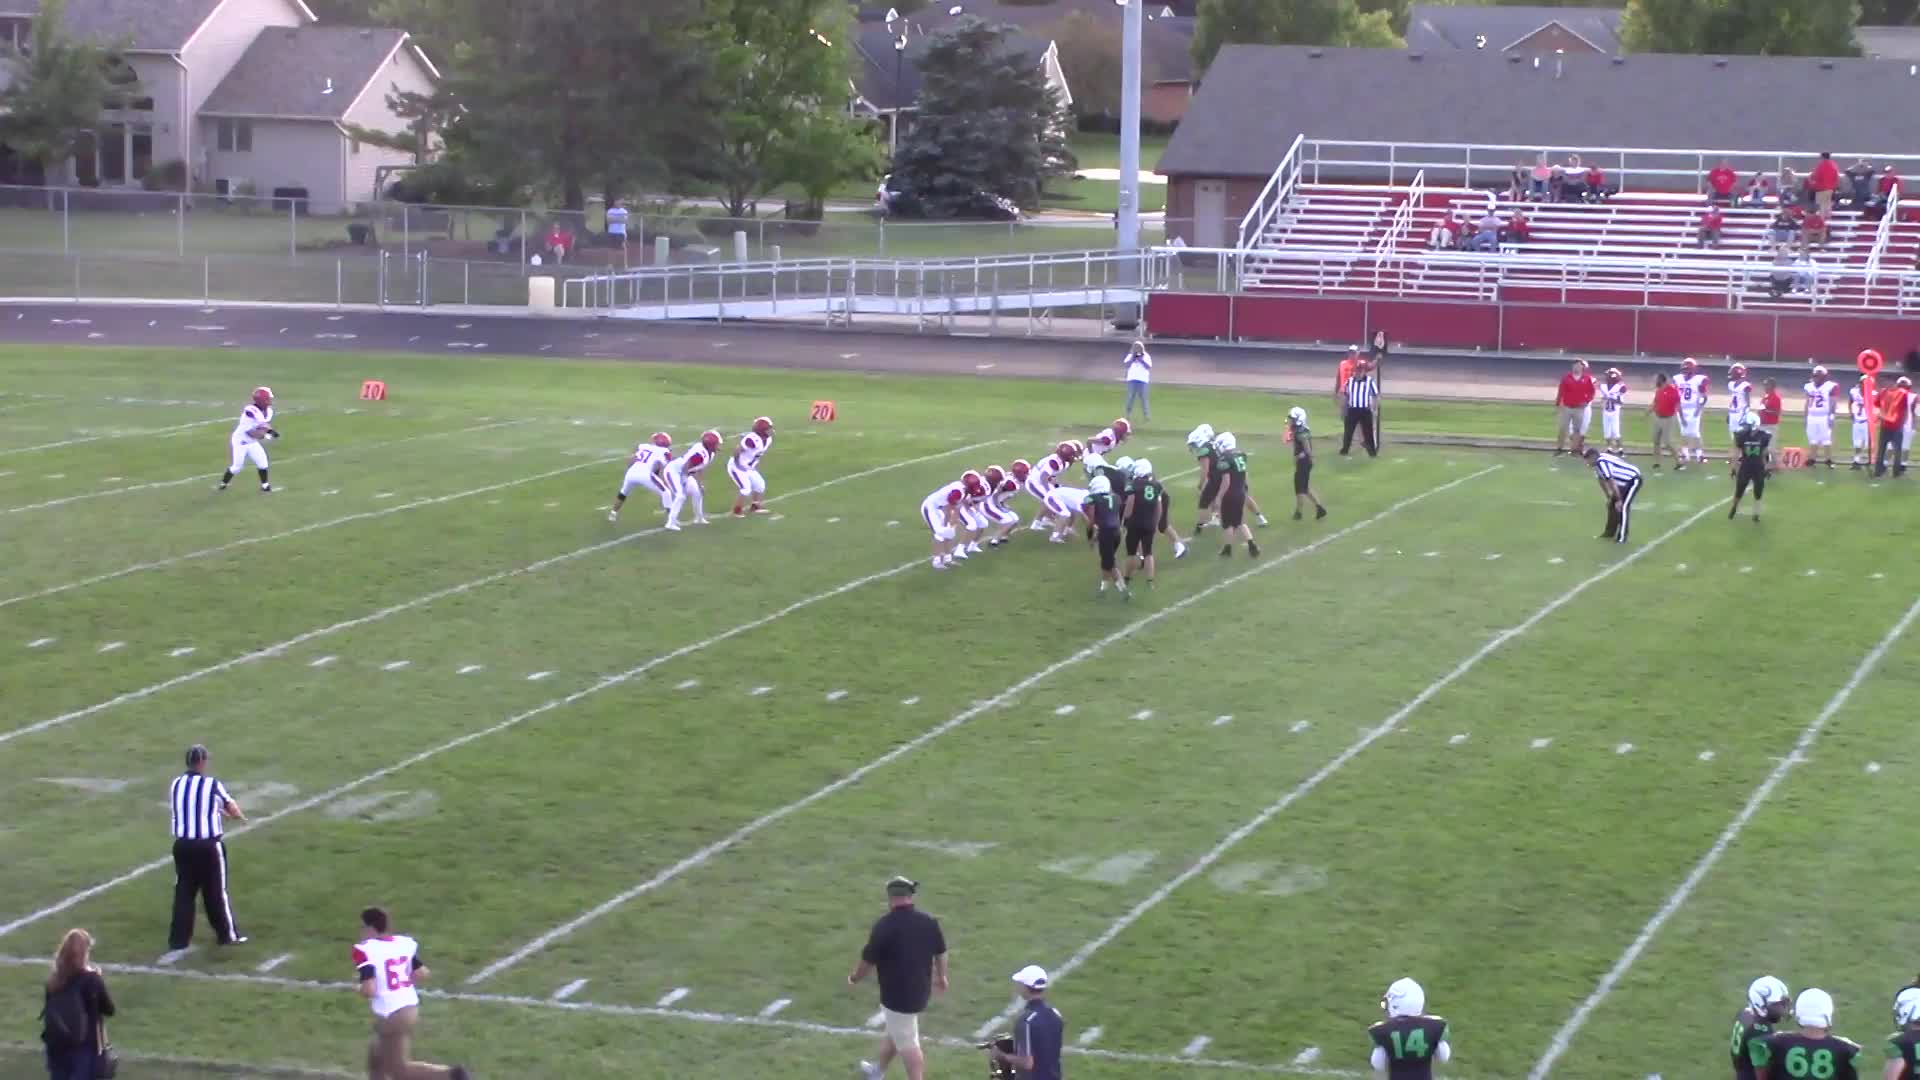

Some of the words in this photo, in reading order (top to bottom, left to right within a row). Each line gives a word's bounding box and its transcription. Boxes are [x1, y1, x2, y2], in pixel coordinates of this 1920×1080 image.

[812, 405, 829, 420] 20
[1143, 484, 1156, 502] 8
[1389, 1028, 1429, 1059] 14
[1785, 1046, 1834, 1080] 68
